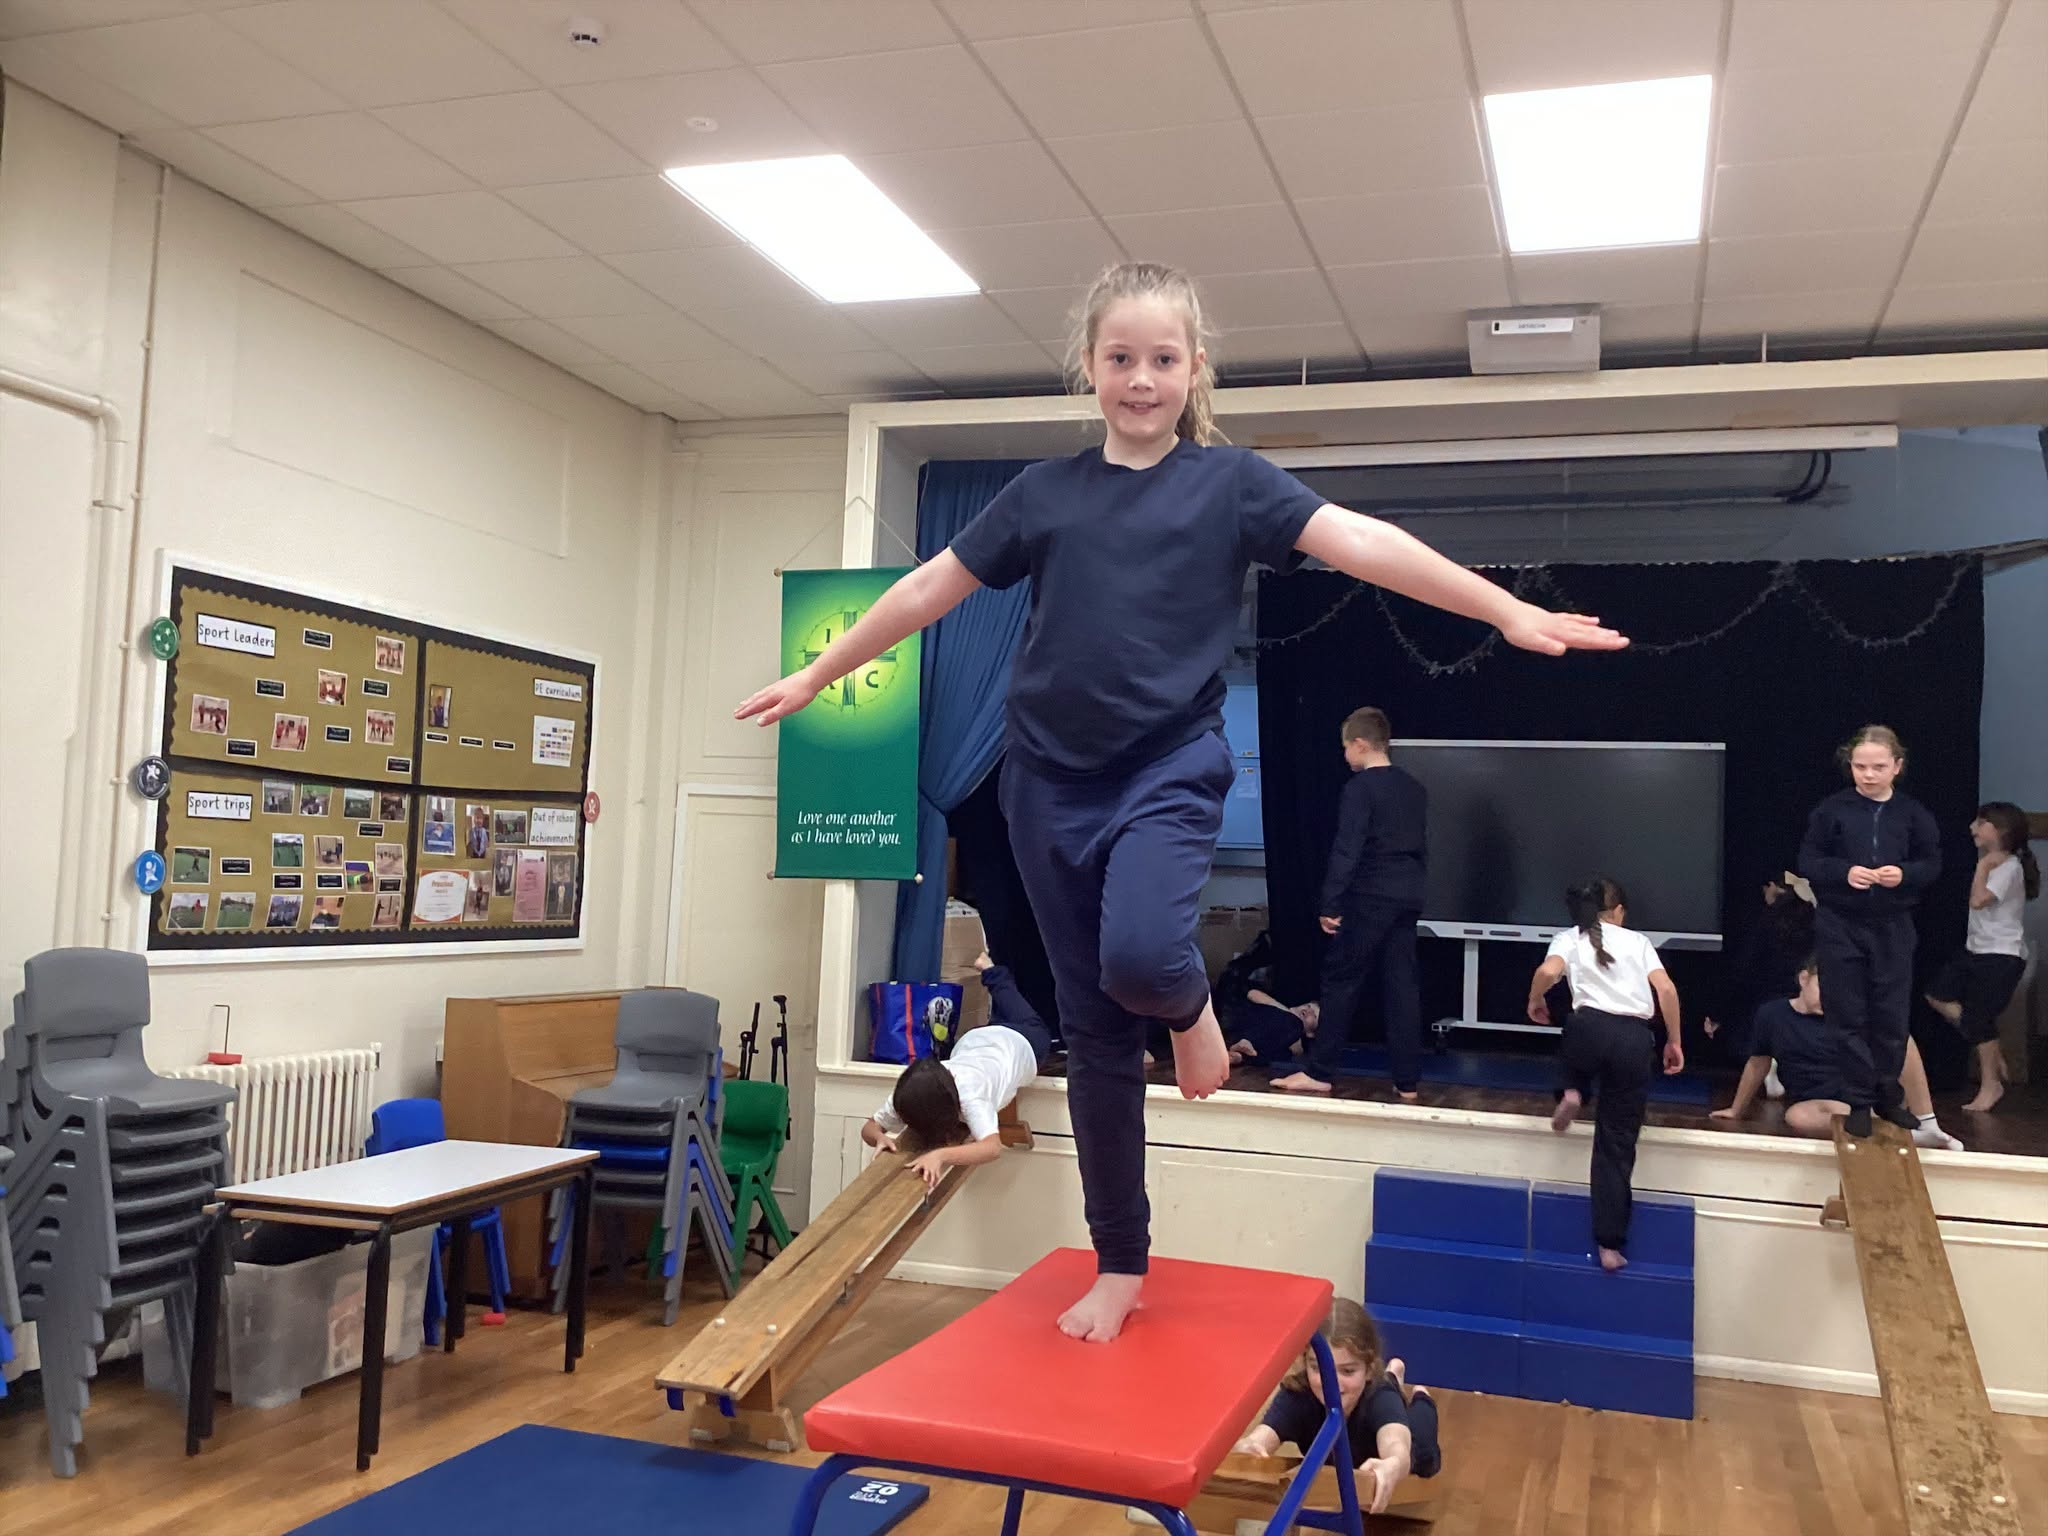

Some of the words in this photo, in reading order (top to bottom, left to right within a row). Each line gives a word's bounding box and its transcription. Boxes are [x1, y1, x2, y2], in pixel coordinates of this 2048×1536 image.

[199, 624, 229, 643] Sport
[235, 629, 275, 648] Leaders
[865, 670, 879, 688] C
[545, 687, 581, 698] curriculum
[189, 796, 220, 815] Sport
[224, 796, 250, 816] trips
[533, 812, 546, 822] Out
[548, 811, 555, 824] of
[557, 812, 576, 823] school
[798, 810, 823, 825] Love
[825, 813, 847, 825] one
[849, 810, 897, 825] another
[531, 832, 574, 844] achievements
[791, 831, 804, 843] as
[806, 830, 811, 843] I
[814, 828, 842, 844] have
[845, 828, 876, 844] loved
[878, 833, 901, 848] you.
